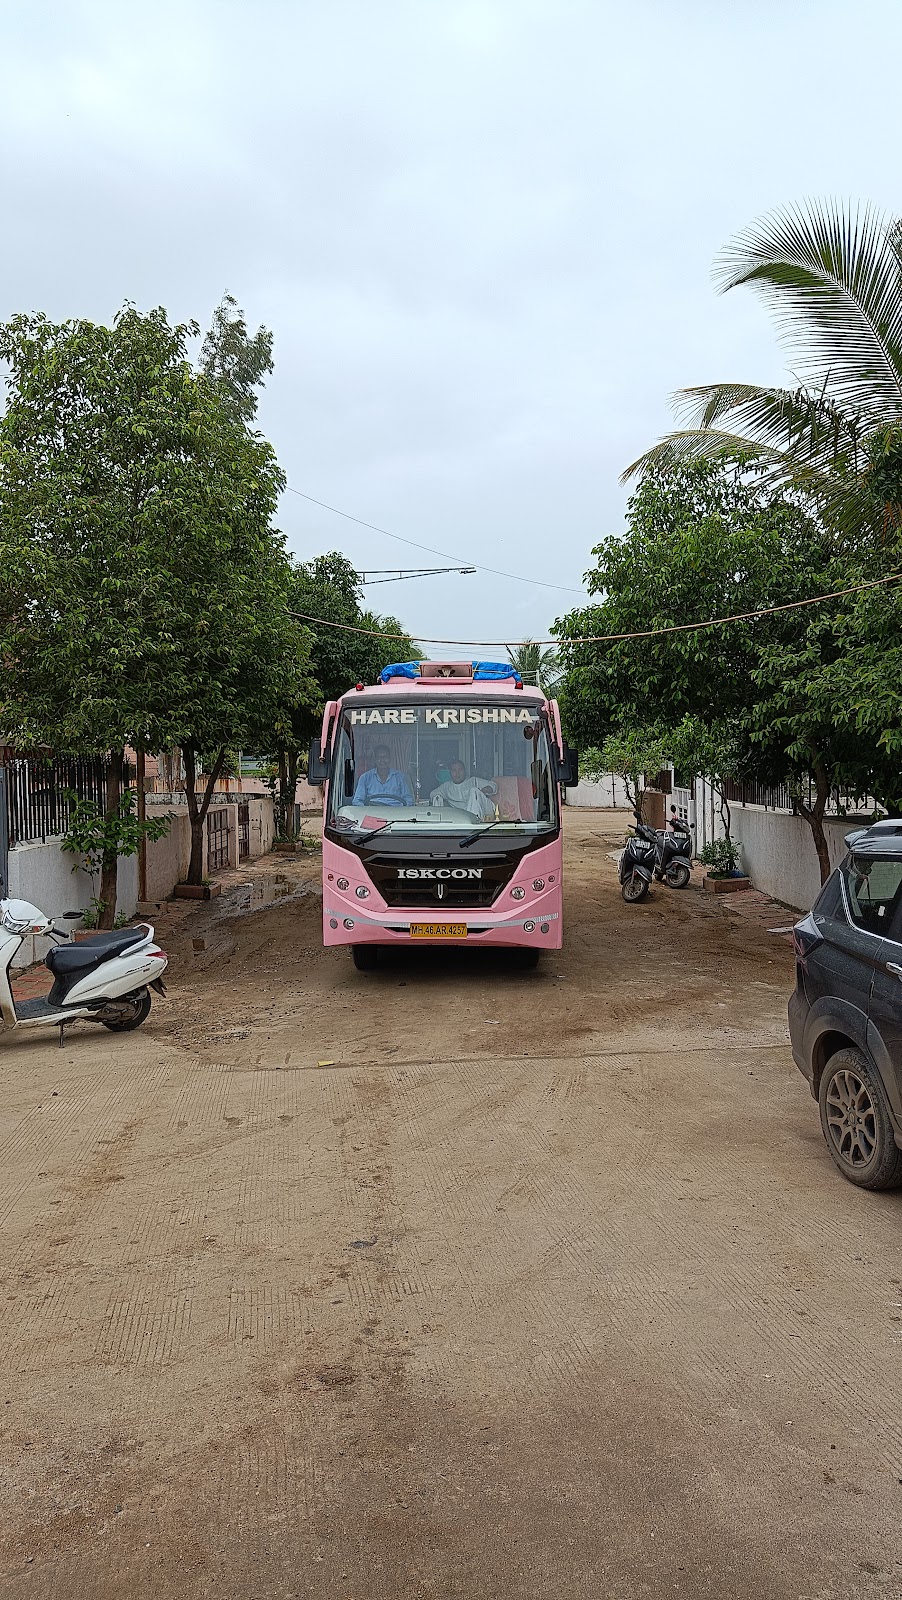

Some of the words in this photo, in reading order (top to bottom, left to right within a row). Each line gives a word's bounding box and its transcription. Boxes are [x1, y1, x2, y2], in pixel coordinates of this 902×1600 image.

[350, 709, 415, 725] HARE
[425, 708, 534, 724] KRISHNA
[397, 868, 484, 879] ISKCON
[411, 925, 466, 935] MH.46.AR.4257
